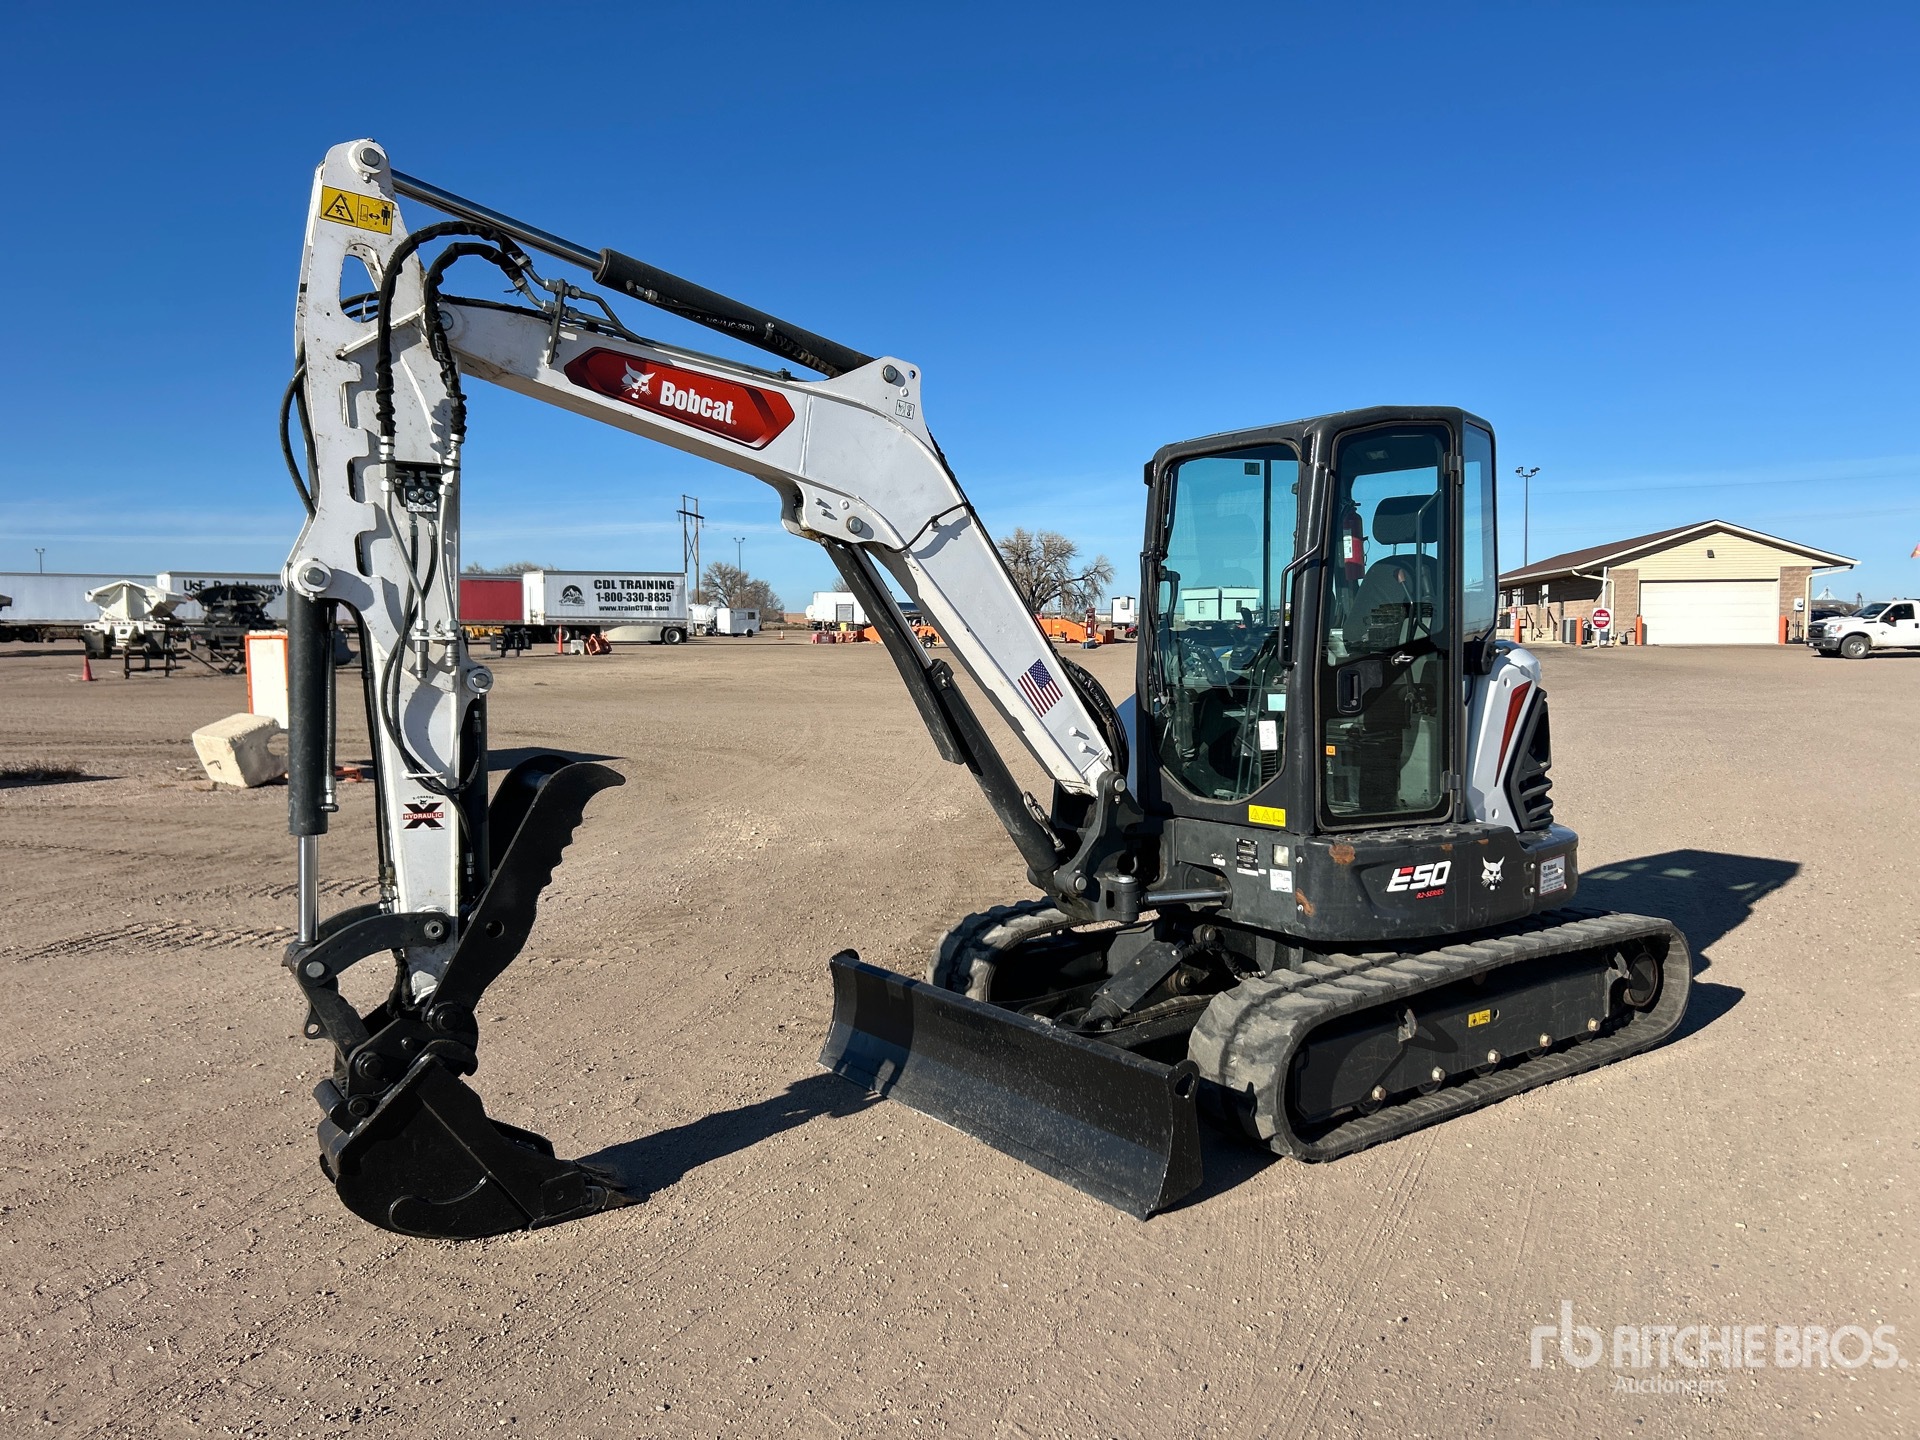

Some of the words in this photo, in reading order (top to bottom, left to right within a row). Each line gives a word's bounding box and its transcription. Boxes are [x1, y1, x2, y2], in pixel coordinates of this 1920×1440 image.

[660, 380, 733, 425] Bobcat
[594, 580, 617, 590] CDL
[619, 580, 675, 590] TRAINING
[596, 592, 672, 602] 1-800-330-8835
[404, 812, 443, 820] HYDRAULIC
[1386, 860, 1452, 892] E50
